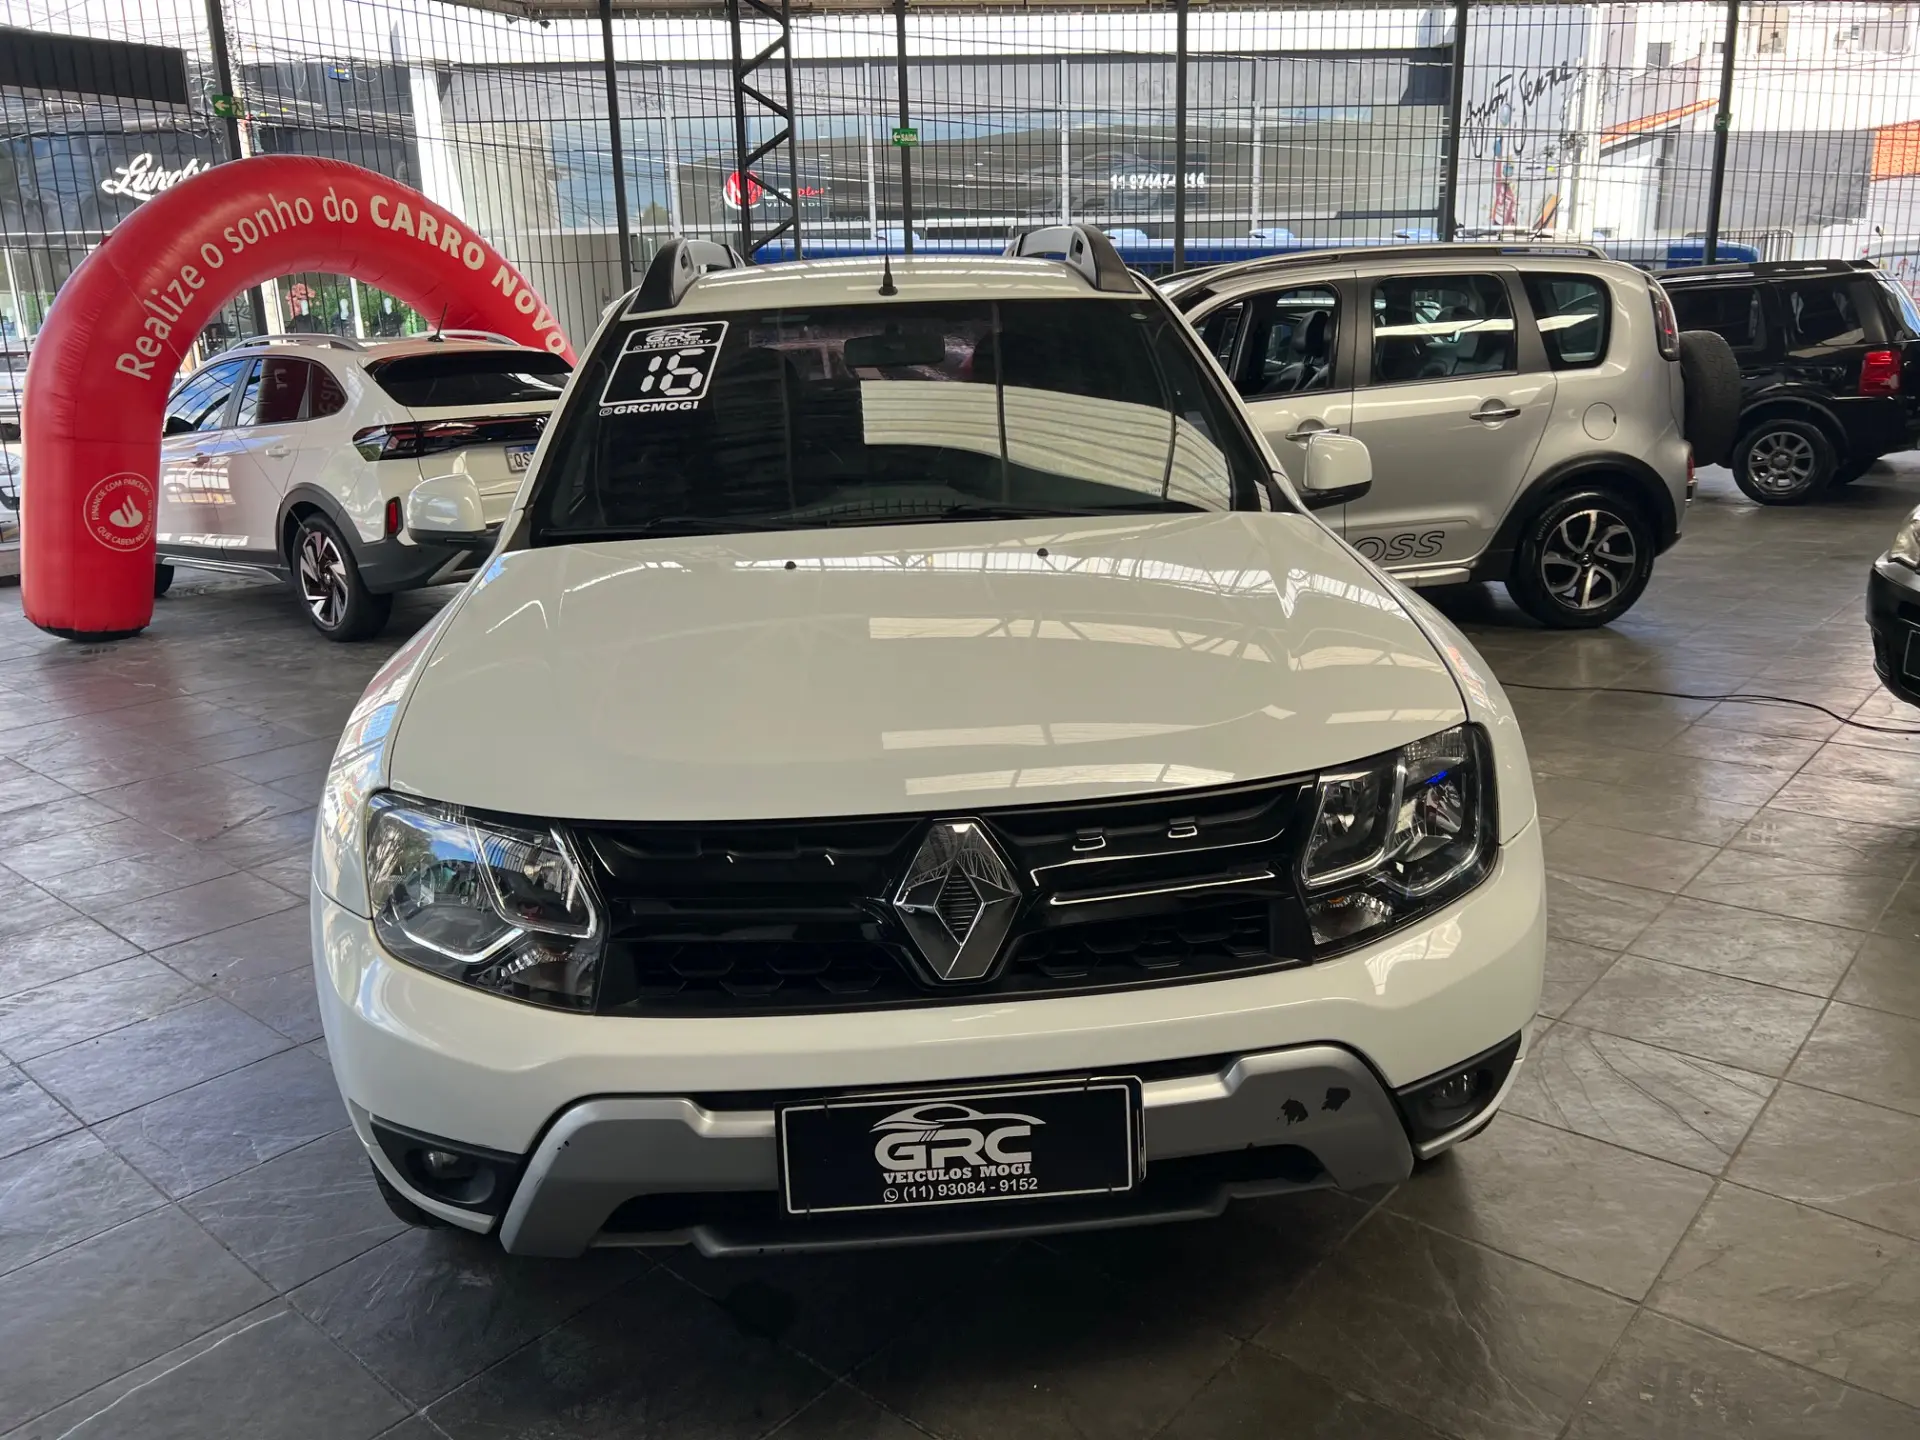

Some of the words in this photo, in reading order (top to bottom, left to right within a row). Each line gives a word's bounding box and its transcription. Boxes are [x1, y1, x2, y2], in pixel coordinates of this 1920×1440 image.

[116, 264, 206, 380] Realize
[200, 242, 224, 269] o
[223, 193, 314, 254] sonho
[322, 186, 359, 224] do
[370, 195, 485, 271] CARRO
[491, 264, 567, 355] NOVO
[640, 347, 706, 396] 16
[105, 480, 123, 492] COM
[97, 526, 113, 540] QUE
[111, 536, 136, 546] CABEM
[874, 1125, 1032, 1171] GRC
[883, 1167, 972, 1184] VEICULOS
[979, 1163, 1031, 1178] MOGI
[903, 1184, 934, 1201] (11)
[938, 1181, 986, 1196] 93084
[1000, 1177, 1038, 1192] 9152
